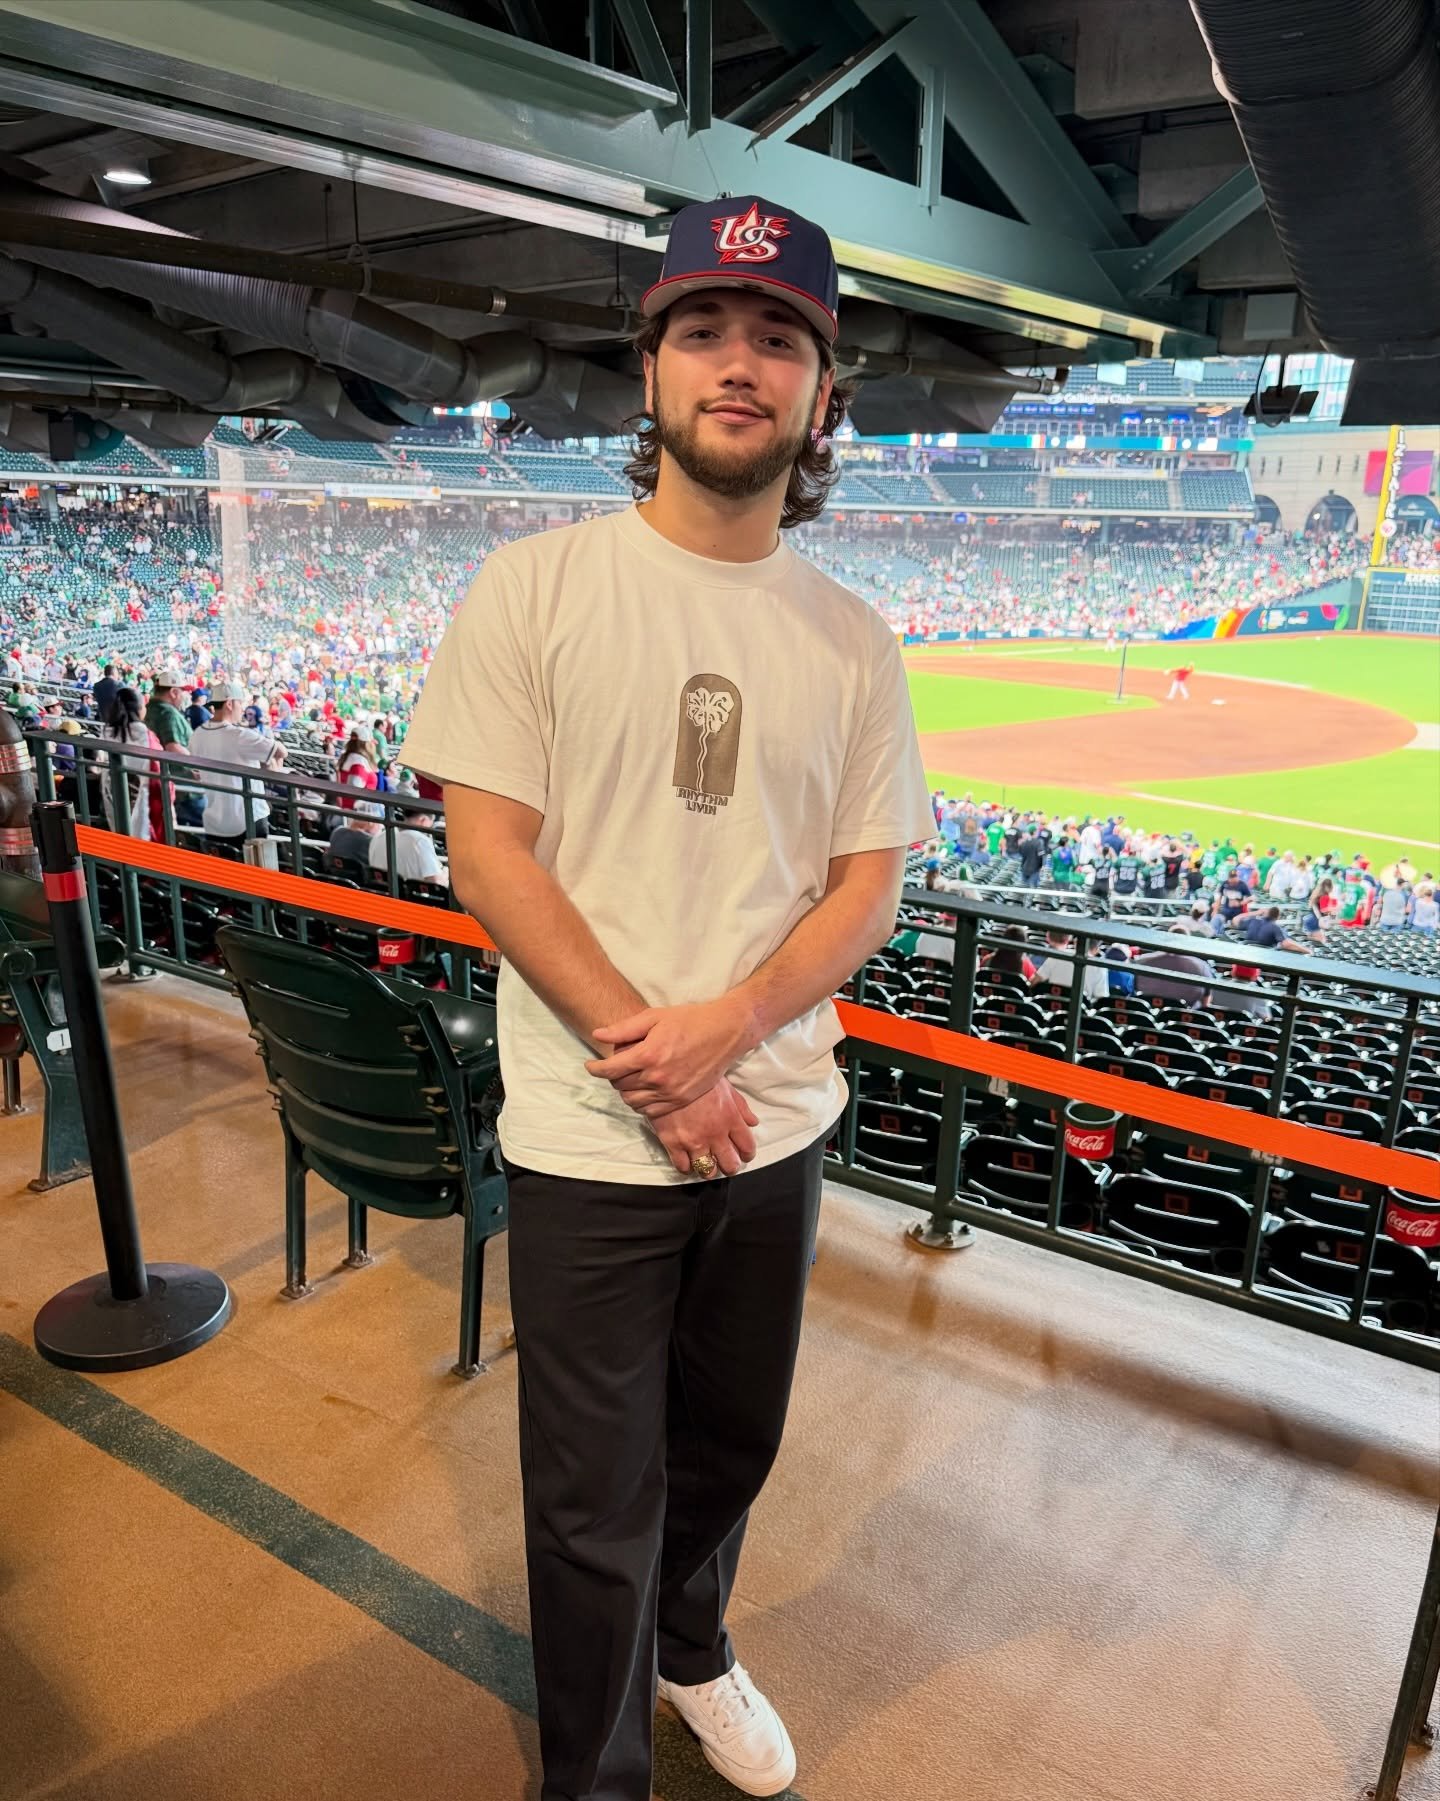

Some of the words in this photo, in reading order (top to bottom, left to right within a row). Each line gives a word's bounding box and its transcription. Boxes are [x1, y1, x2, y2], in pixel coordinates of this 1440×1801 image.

[1109, 392, 1134, 404] Club
[676, 787, 728, 806] RHYTHM
[685, 799, 717, 815] LIVIN
[1064, 1128, 1106, 1151] Coca-Cola
[1386, 1210, 1438, 1237] Coca-Cola
